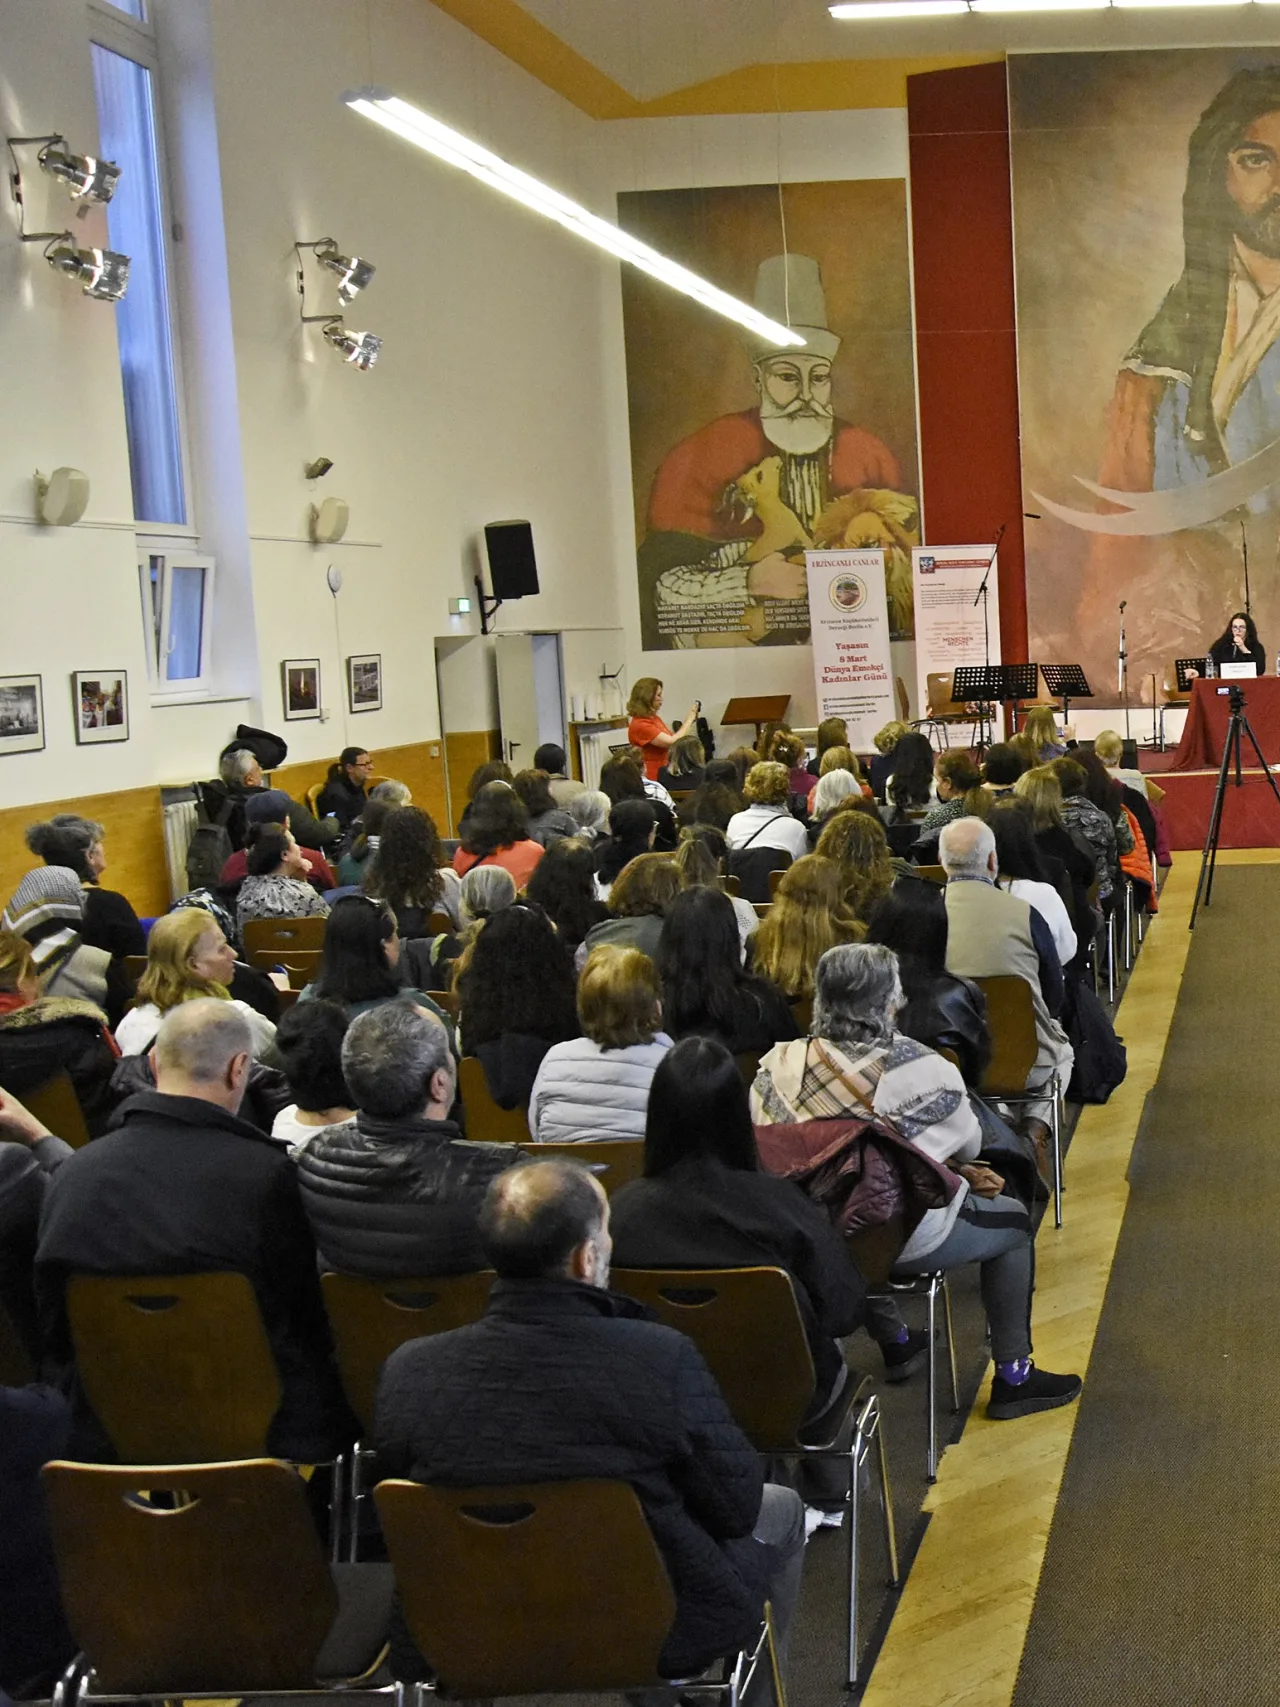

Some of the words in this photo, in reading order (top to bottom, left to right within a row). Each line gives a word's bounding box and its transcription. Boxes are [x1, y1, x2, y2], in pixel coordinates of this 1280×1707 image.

[836, 643, 869, 651] Yaşasın
[847, 655, 867, 663] Mart
[824, 665, 851, 674] Dünya
[852, 663, 884, 673] Emekçi
[822, 675, 861, 683] Kadınlar
[864, 673, 888, 682] Günü
